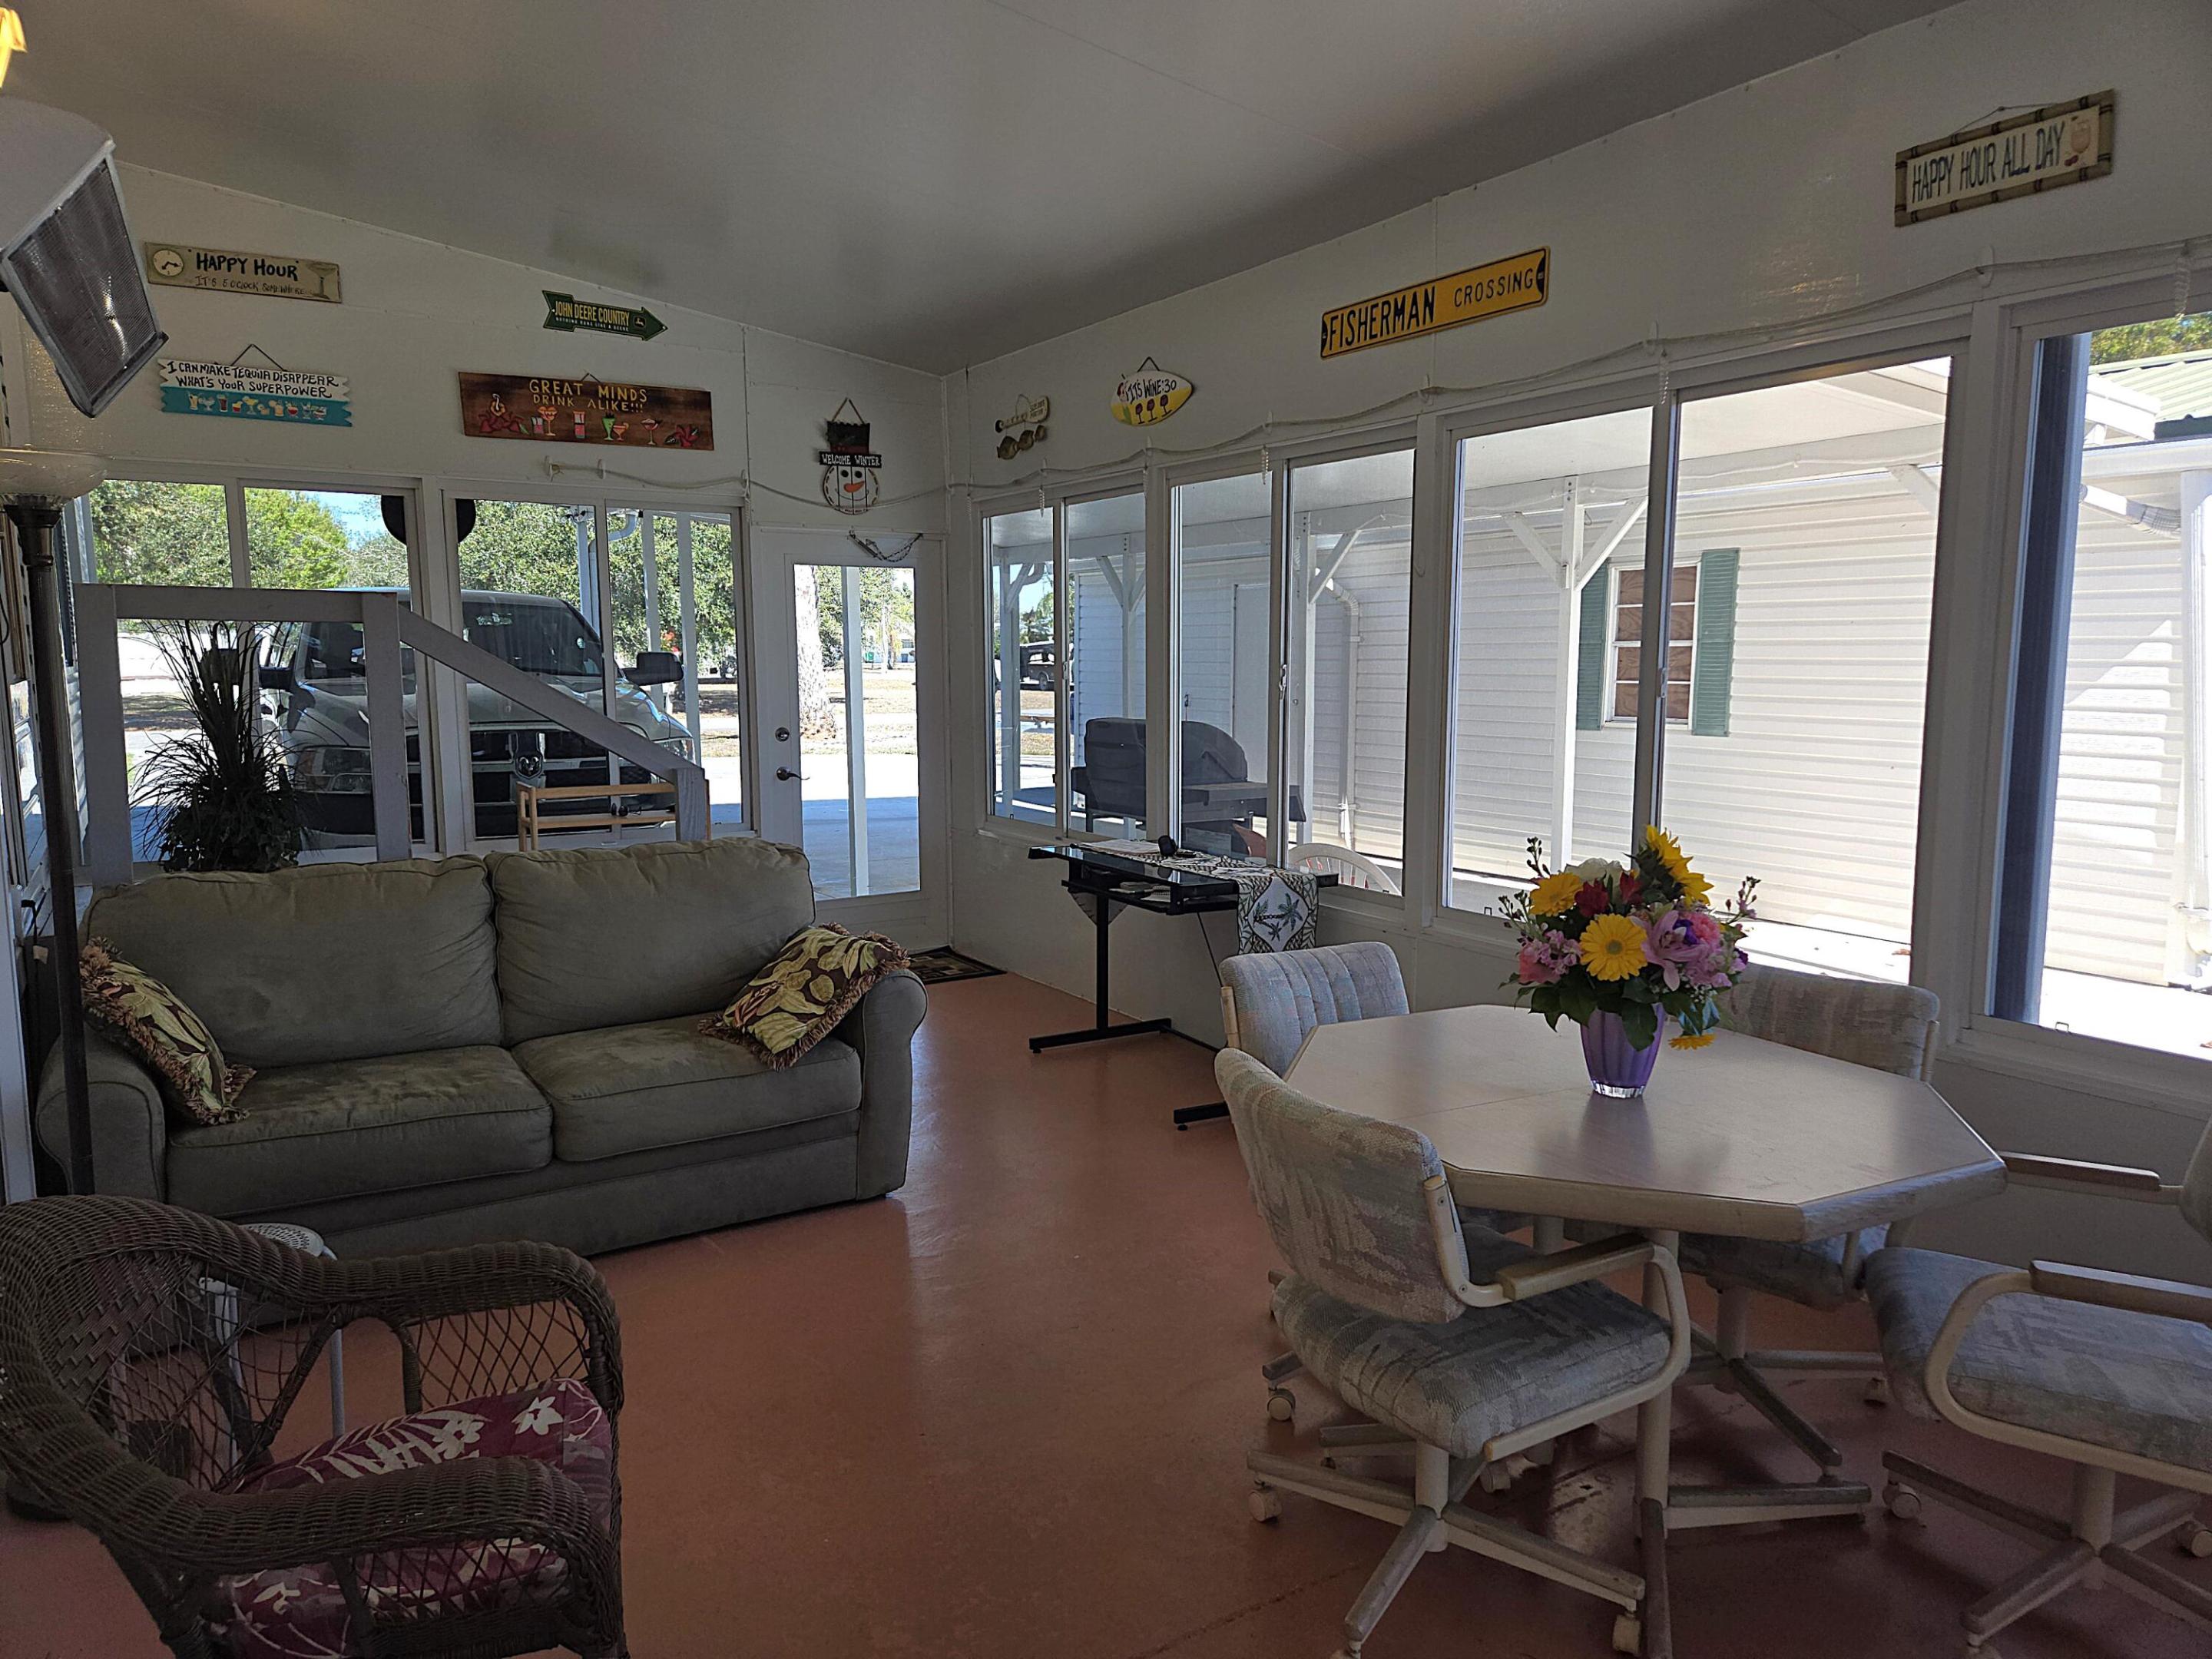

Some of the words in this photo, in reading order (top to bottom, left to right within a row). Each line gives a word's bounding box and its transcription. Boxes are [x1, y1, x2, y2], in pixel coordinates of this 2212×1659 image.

[1912, 154, 1954, 203] HAPPY
[1959, 143, 1996, 190] HOUR
[2002, 133, 2031, 180] ALL
[2035, 121, 2065, 171] DAY
[196, 252, 248, 274] HAPPY
[254, 258, 298, 281] HOUR
[222, 278, 228, 287] 5
[555, 300, 573, 318] JOHN
[574, 303, 598, 323] DEERE
[598, 306, 630, 326] COUNTRY
[1329, 286, 1435, 351] FISHERMAN
[1454, 268, 1534, 308] CROSSING
[167, 361, 177, 374] I
[178, 363, 199, 374] CAN
[200, 364, 230, 376] MAKE
[177, 376, 214, 388] WHAT'S
[249, 382, 332, 398] SUPERPOWER
[529, 379, 583, 396] GREAT
[598, 385, 647, 403] MINDS
[533, 393, 575, 407] DRINK
[587, 398, 644, 413] ALIKE!!!
[822, 453, 851, 465] WELCOME
[854, 455, 880, 466] WINTER
